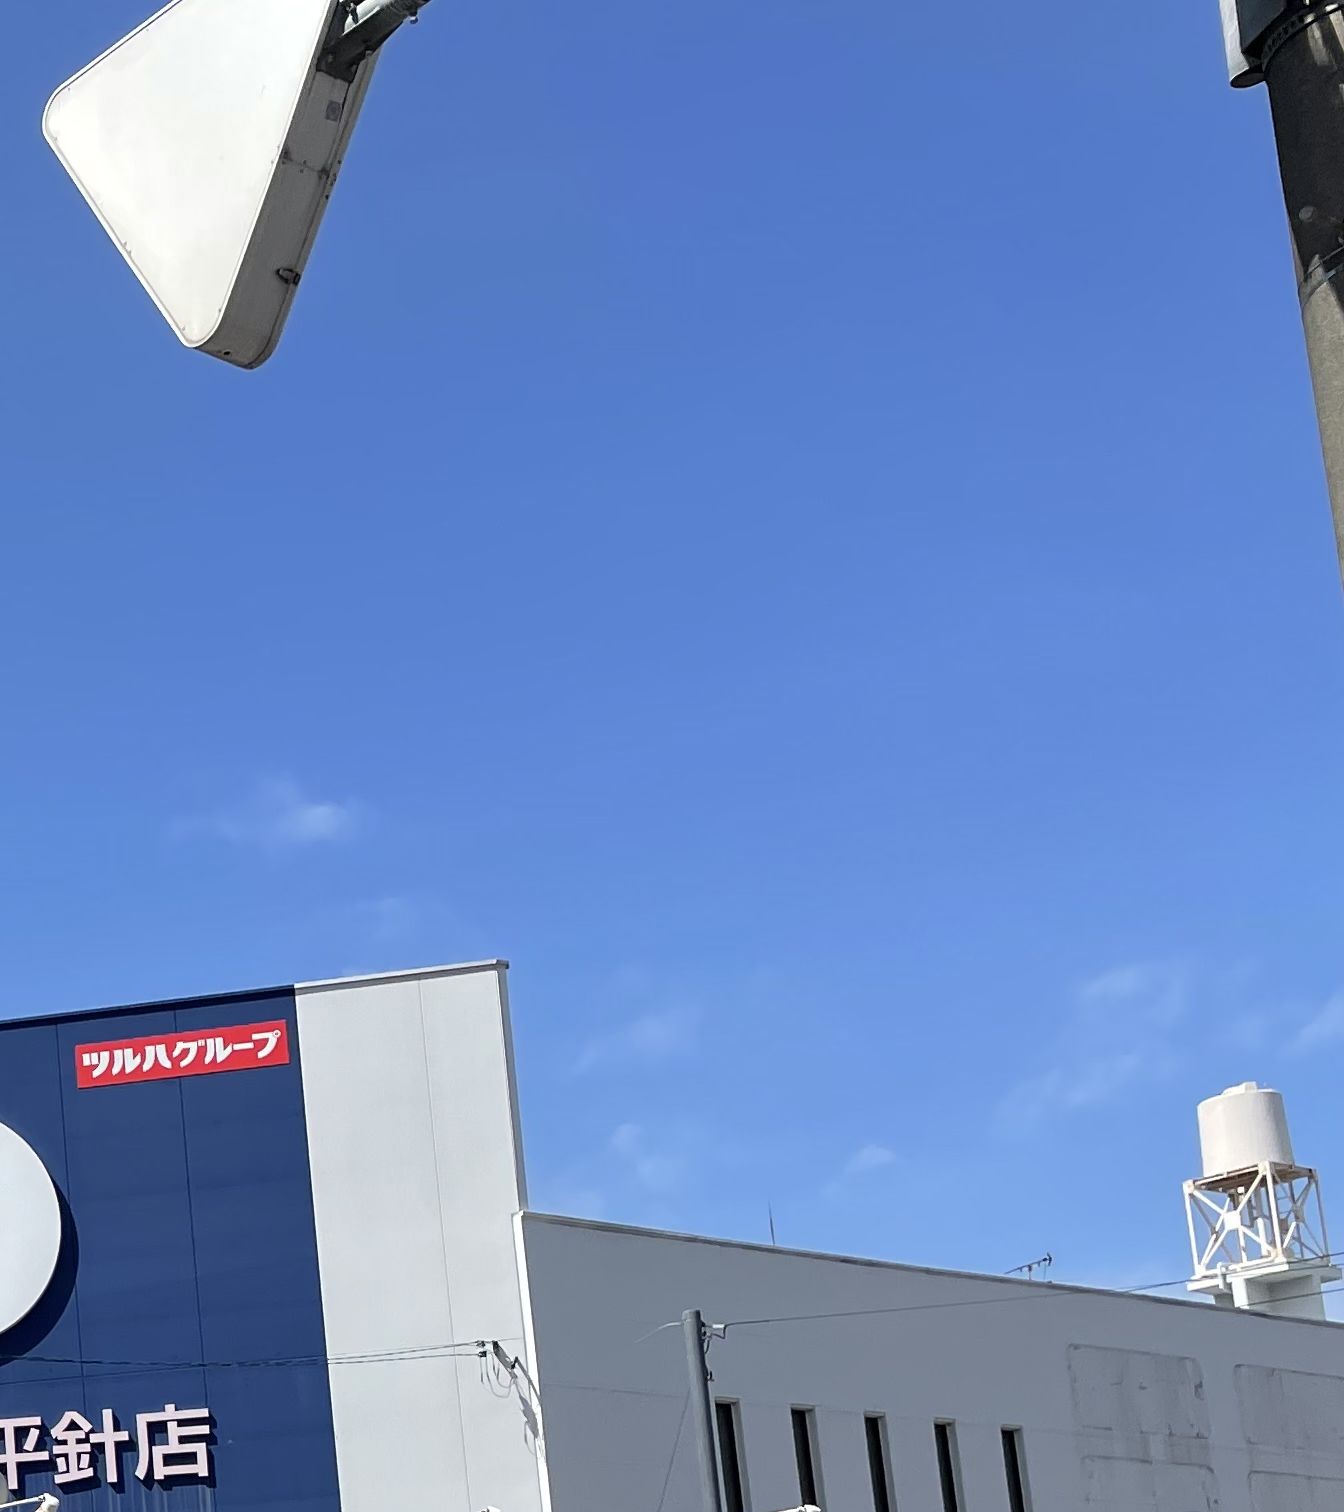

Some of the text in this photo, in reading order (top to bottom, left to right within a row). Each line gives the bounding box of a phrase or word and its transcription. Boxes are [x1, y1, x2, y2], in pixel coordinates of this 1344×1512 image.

[80, 1028, 281, 1079] ツルハグループ
